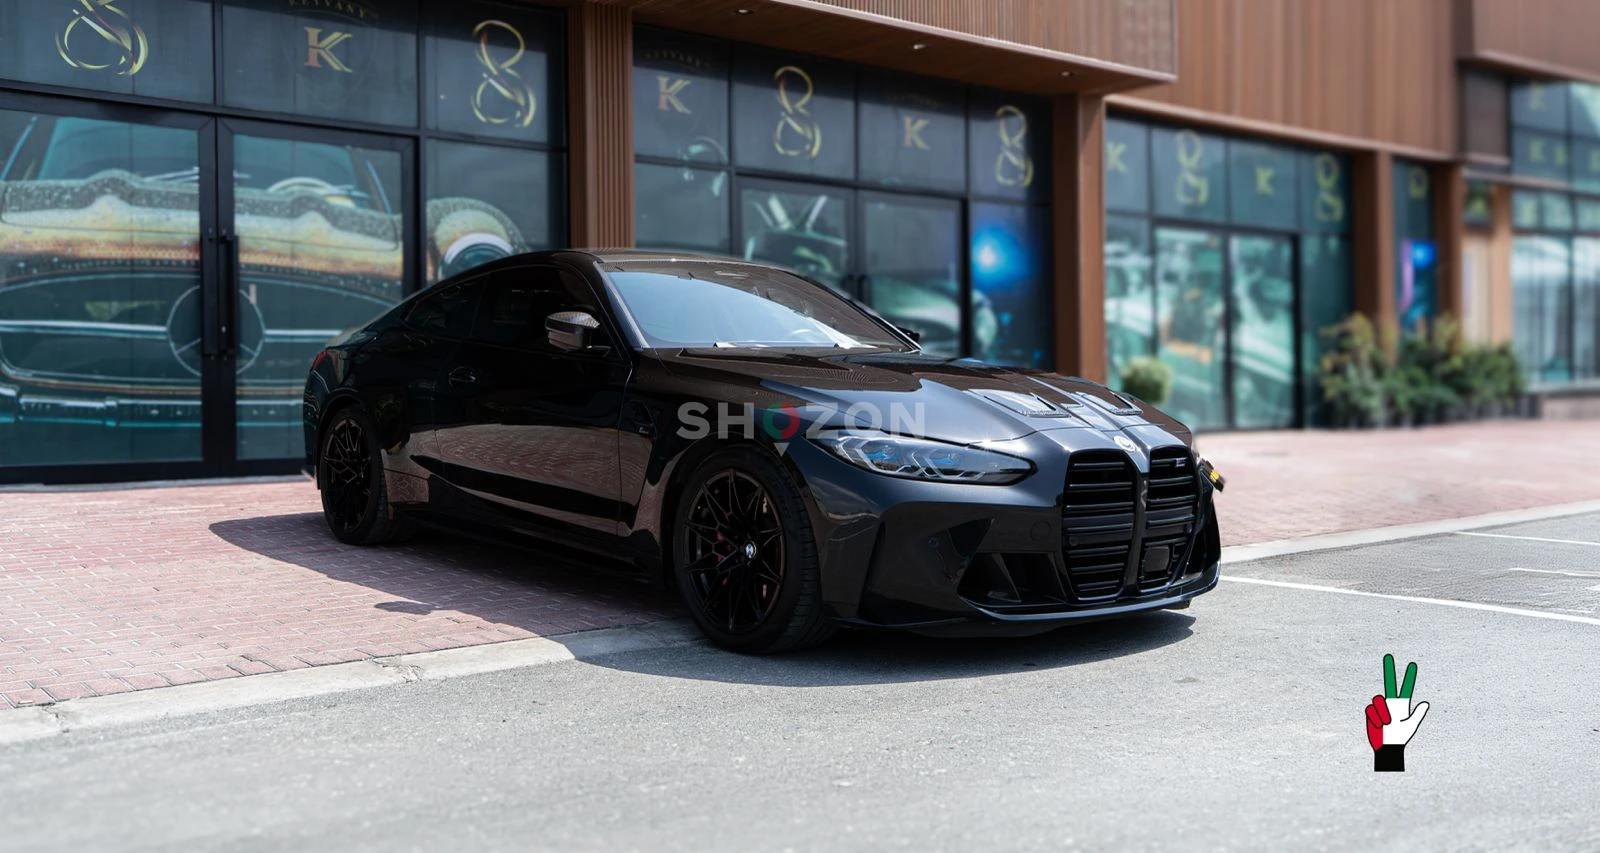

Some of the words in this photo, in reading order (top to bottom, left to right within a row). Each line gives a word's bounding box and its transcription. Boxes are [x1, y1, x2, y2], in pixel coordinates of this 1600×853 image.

[304, 26, 353, 73] K
[656, 76, 691, 114] K
[903, 115, 930, 151] K
